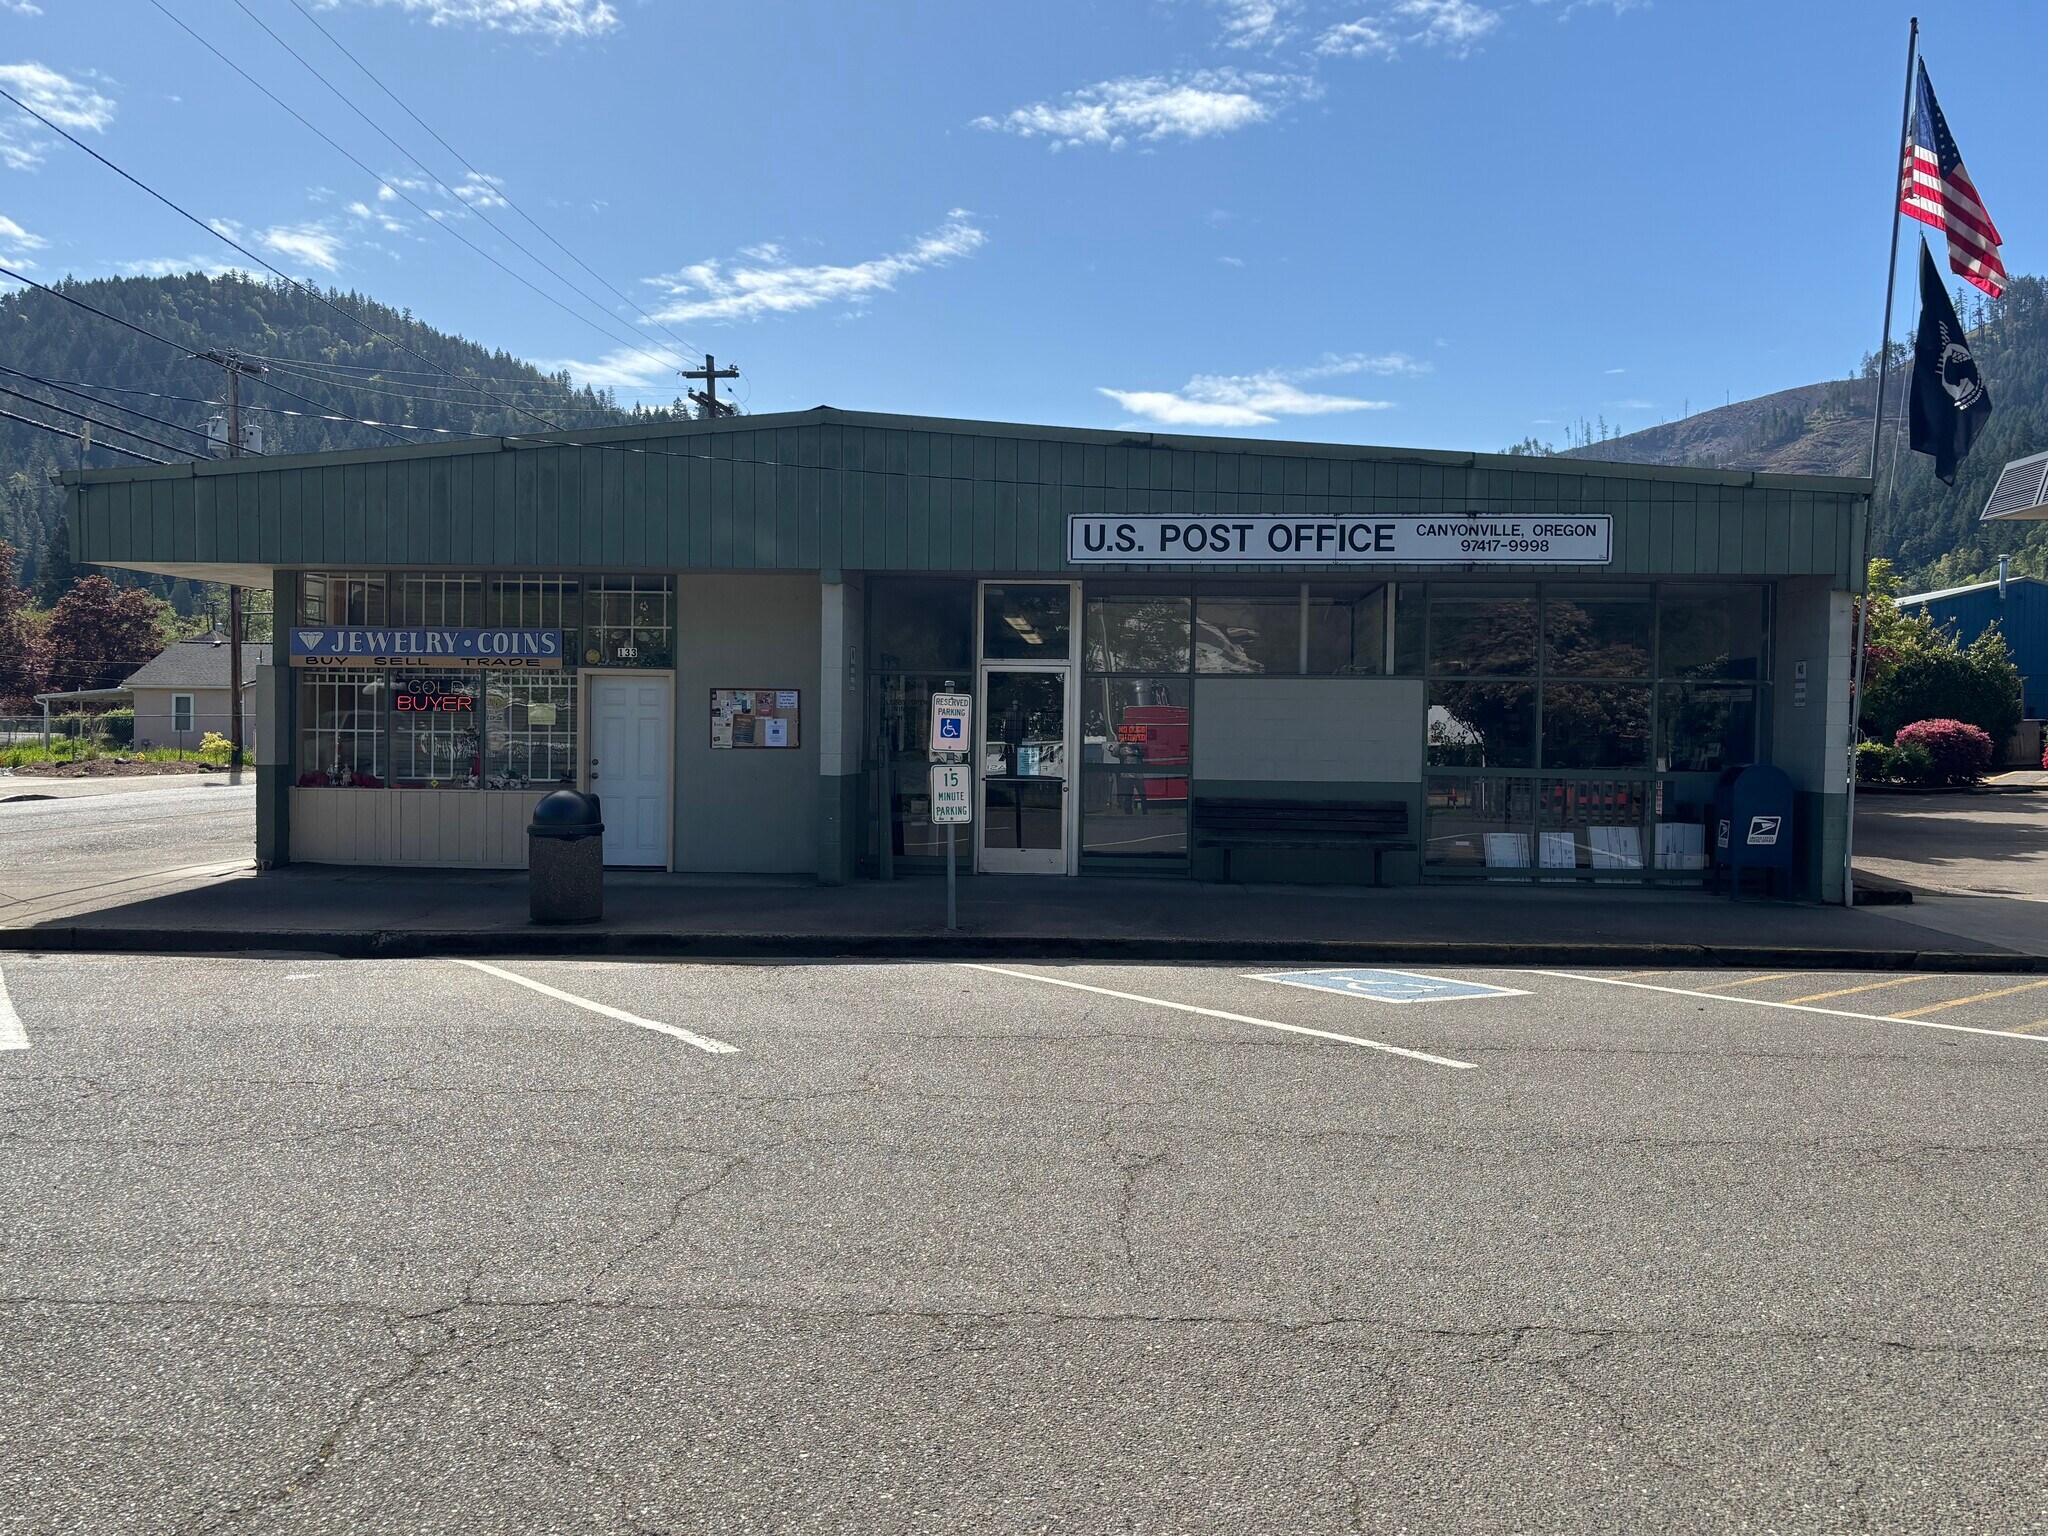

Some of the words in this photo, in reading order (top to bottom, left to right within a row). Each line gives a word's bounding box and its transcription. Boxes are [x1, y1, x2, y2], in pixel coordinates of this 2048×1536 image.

[1084, 524, 1144, 553] U.S.
[1159, 524, 1254, 553] POST
[1267, 524, 1396, 553] OFFICE
[1416, 524, 1525, 541] CANYONVILLE,
[1532, 524, 1597, 538] OREGON
[1460, 539, 1550, 553] 97417-9998
[330, 631, 459, 654] JEWELRY
[477, 632, 556, 655] COINS
[619, 648, 638, 657] 133
[305, 656, 349, 666] BUY
[374, 656, 430, 666] SELL
[461, 657, 541, 667] TRADE
[408, 679, 466, 695] GOLD
[396, 695, 473, 712] BUYER
[935, 697, 969, 707] RESERVED
[937, 708, 966, 717] PARKING
[944, 772, 959, 787] 15
[938, 791, 965, 801] MINUTE
[936, 806, 968, 816] PARKING
